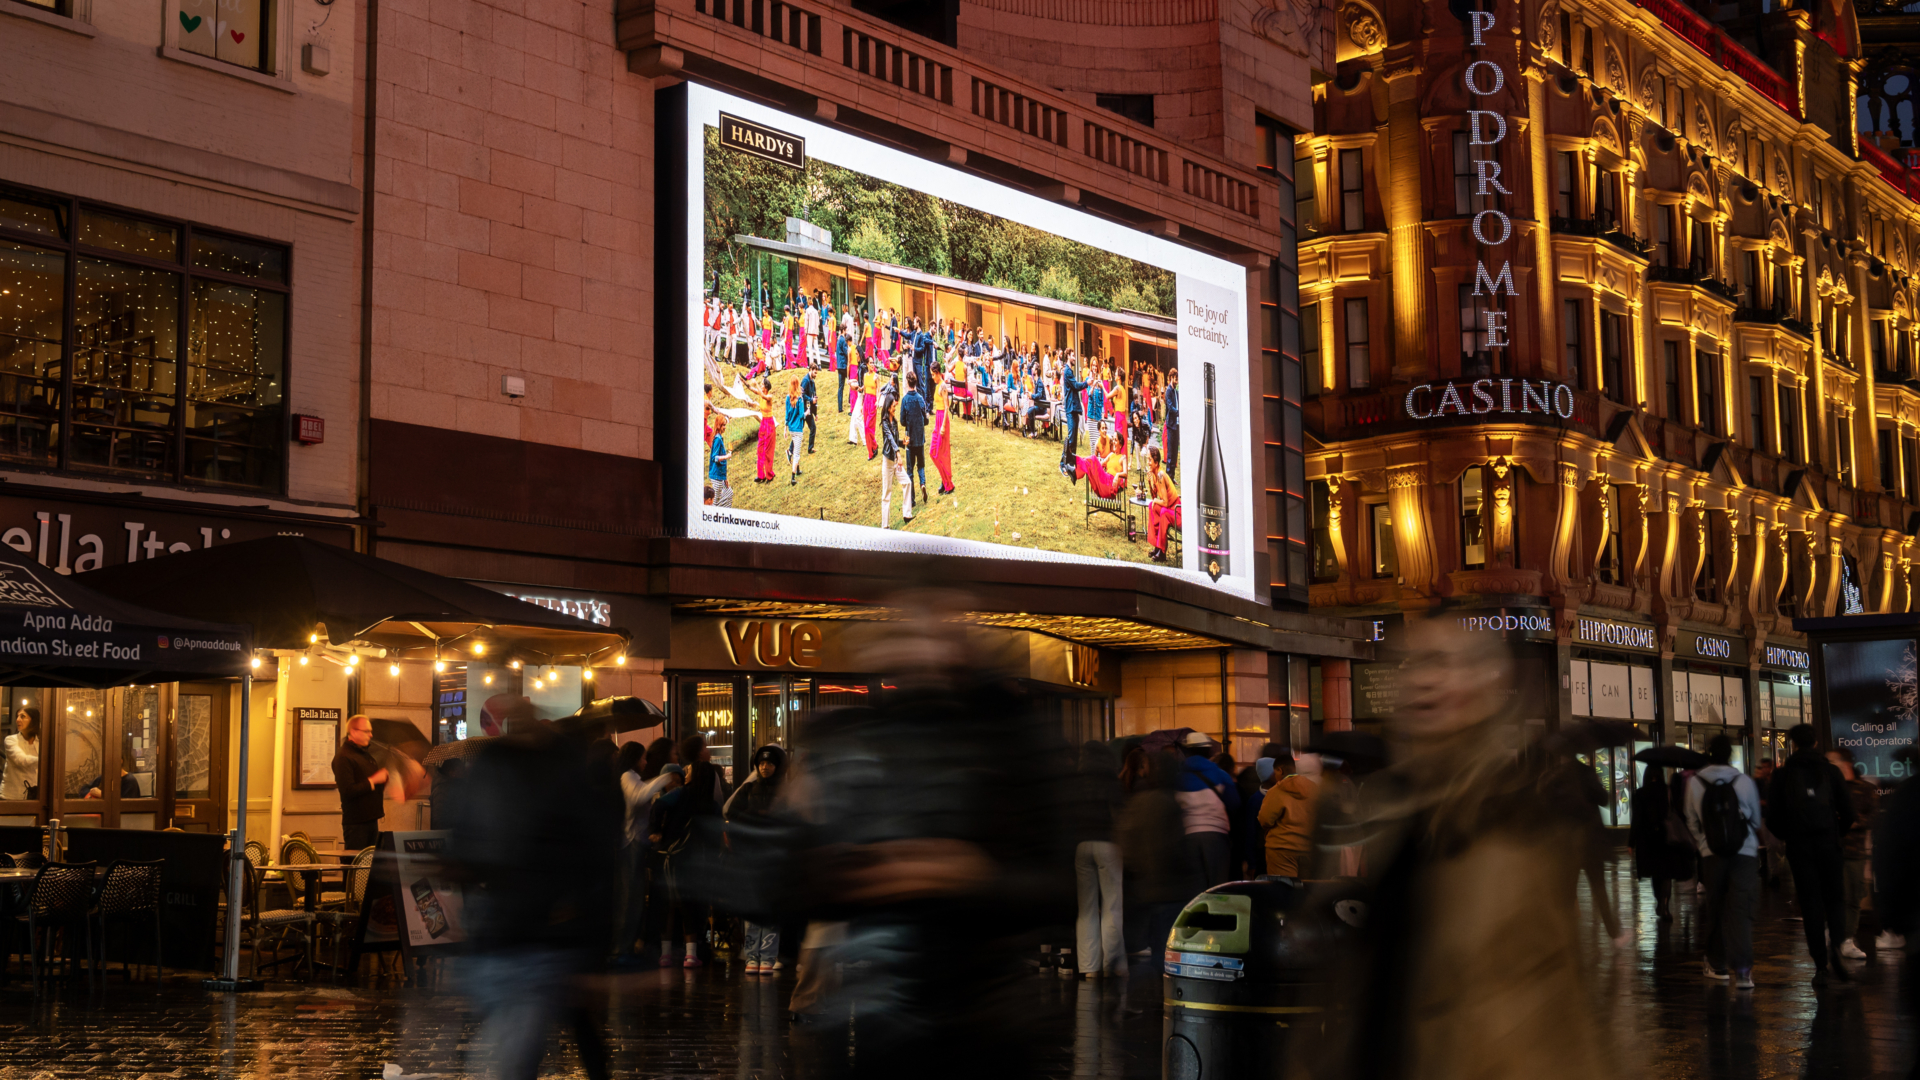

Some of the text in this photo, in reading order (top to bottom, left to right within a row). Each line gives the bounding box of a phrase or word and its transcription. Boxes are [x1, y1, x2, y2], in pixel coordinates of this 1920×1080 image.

[731, 124, 794, 158] HARDYS
[1186, 298, 1229, 325] The joy of
[1188, 324, 1229, 349] certainty.
[1405, 377, 1574, 419] CASINO
[23, 611, 113, 633] Apna Adda
[173, 637, 242, 651] @Apnaaddauk
[723, 620, 823, 668] vue
[1579, 619, 1655, 649] HIPPODROME
[103, 642, 141, 661] Food
[1695, 636, 1730, 658] CASINO
[1364, 668, 1377, 676] Open
[1602, 684, 1620, 698] CAN
[1638, 687, 1648, 700] BE
[300, 709, 338, 719] Bella Italia
[1851, 721, 1897, 734] Calling all
[1838, 736, 1913, 748] Food Operators
[1875, 756, 1913, 778] Let
[406, 841, 426, 851] NEW
[166, 891, 198, 907] GRILL
